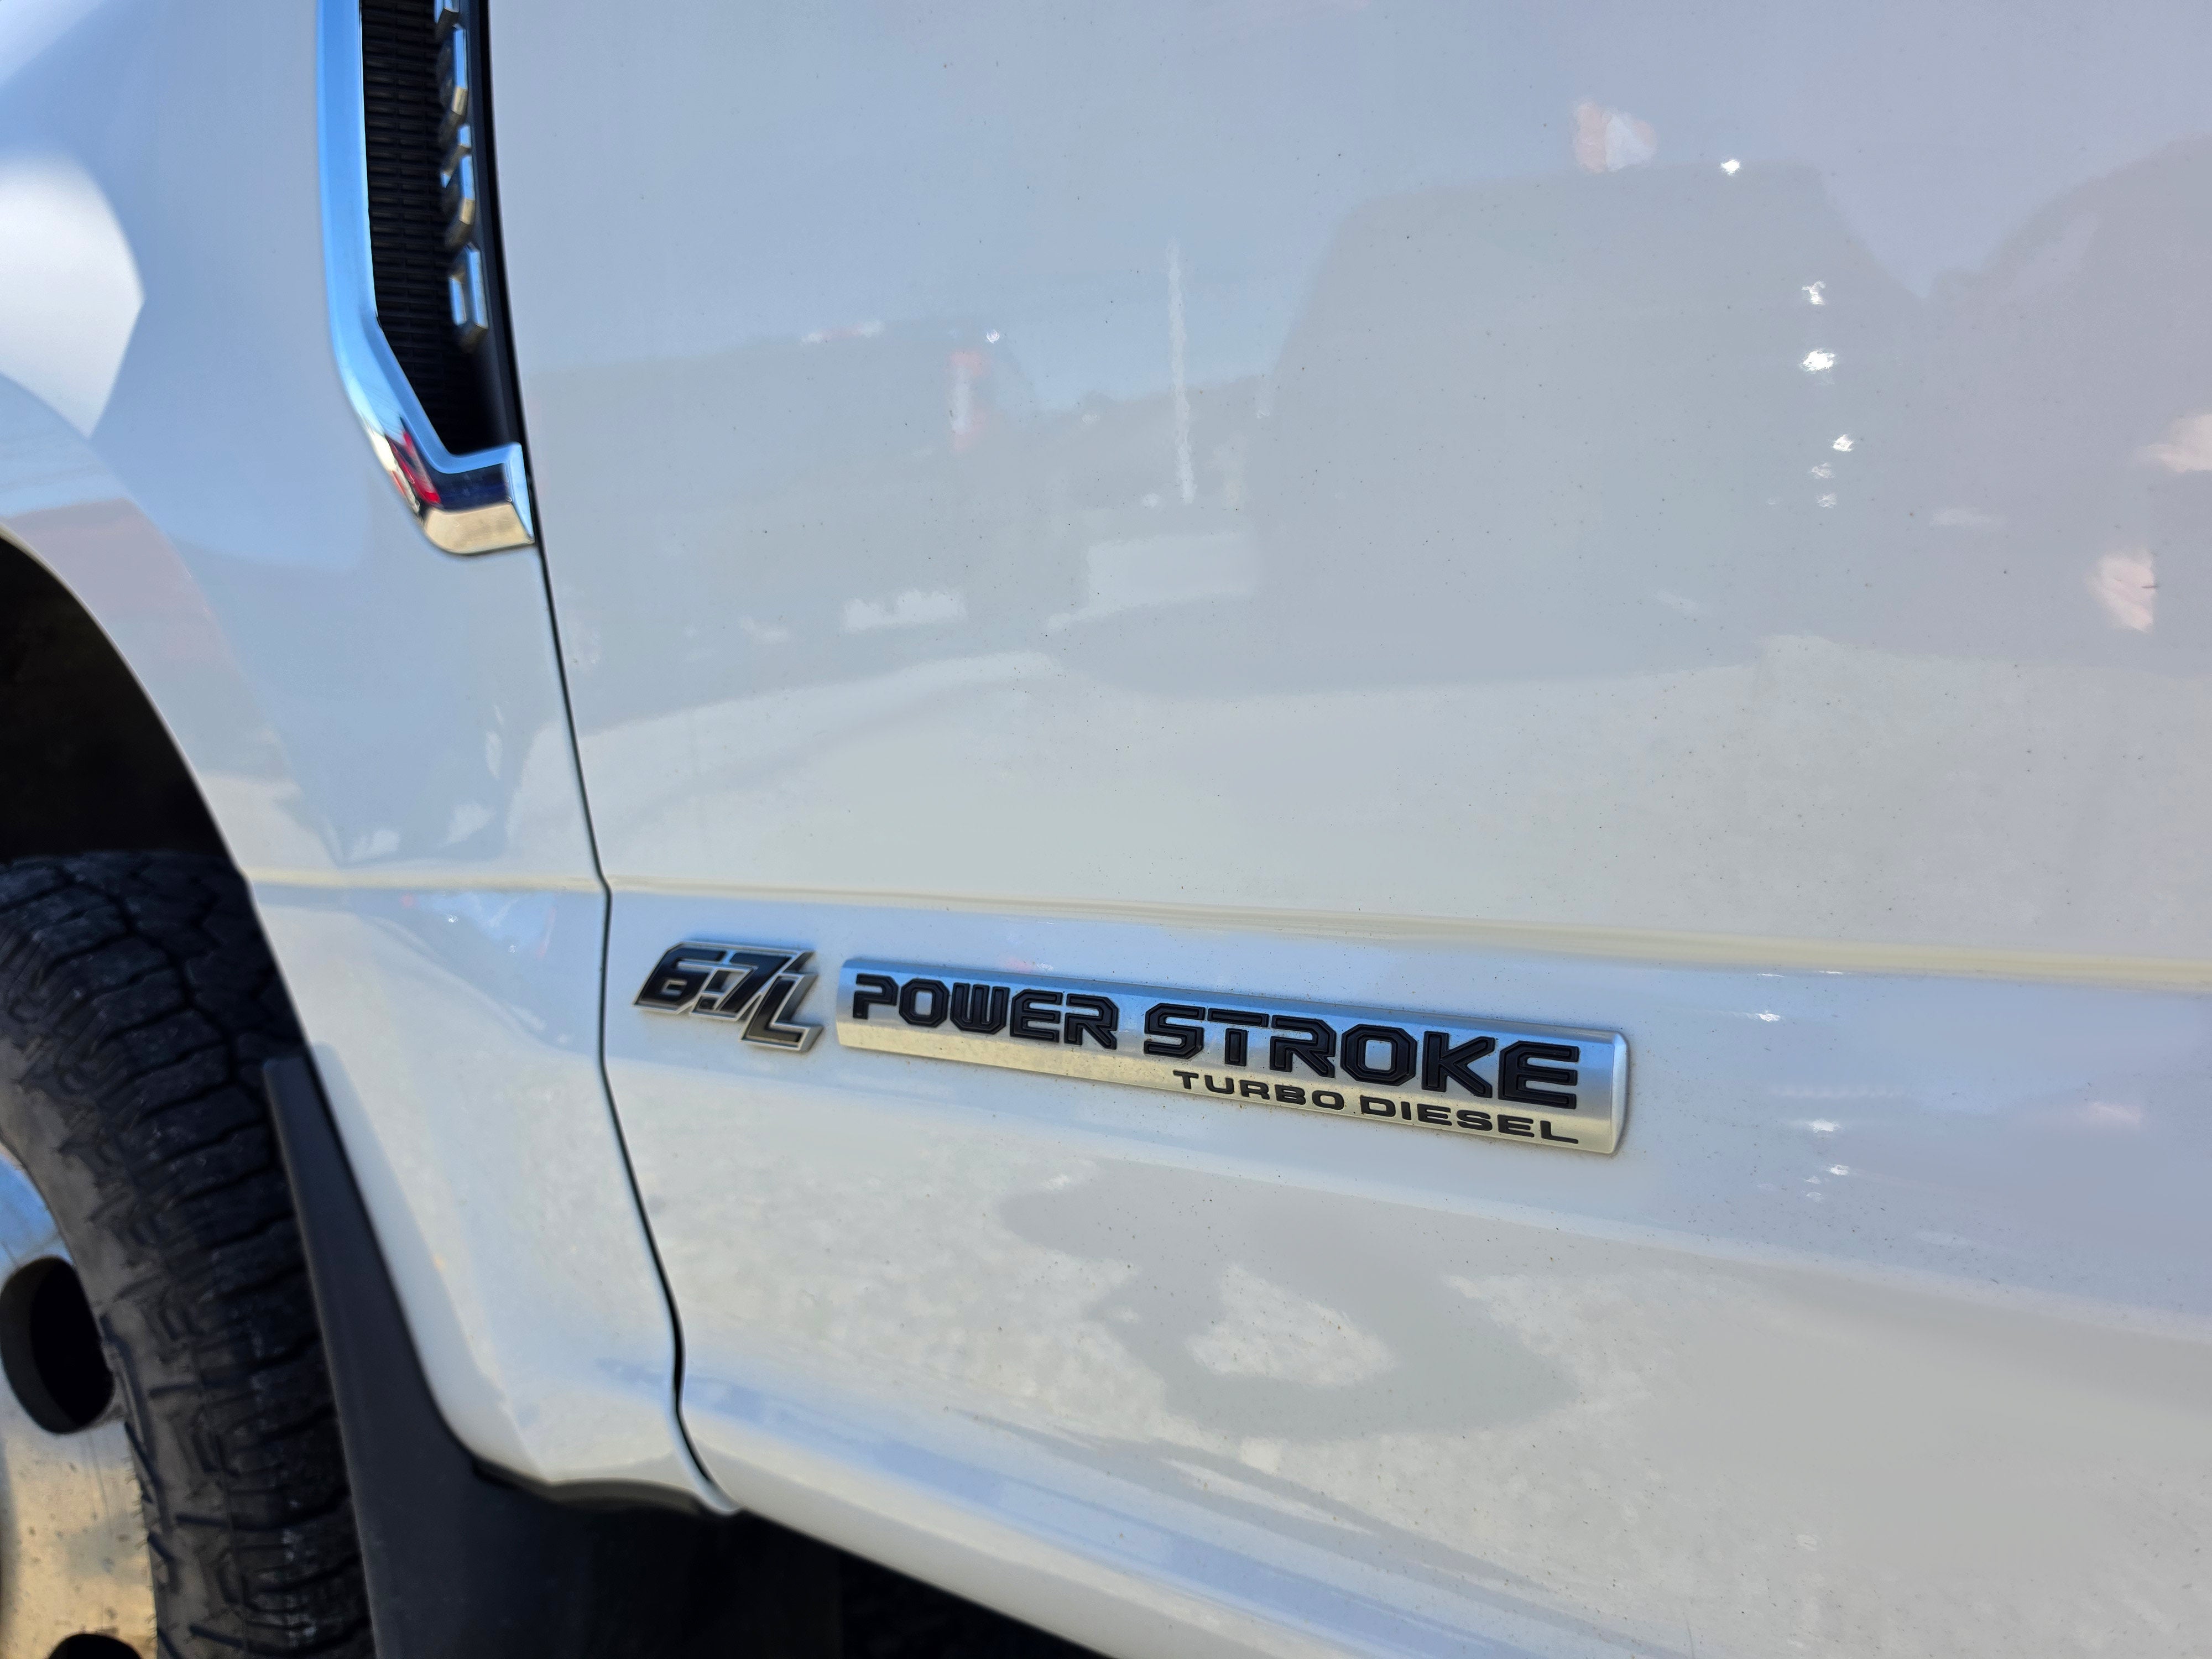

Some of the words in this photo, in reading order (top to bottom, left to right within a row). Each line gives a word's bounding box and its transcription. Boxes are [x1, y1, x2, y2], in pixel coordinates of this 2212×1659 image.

[634, 941, 824, 1051] 6.7L
[852, 973, 1119, 1050] POWER
[1144, 1002, 1580, 1109] STROKE
[1173, 1070, 1345, 1110] TURBO
[1360, 1095, 1579, 1144] DIESEL
